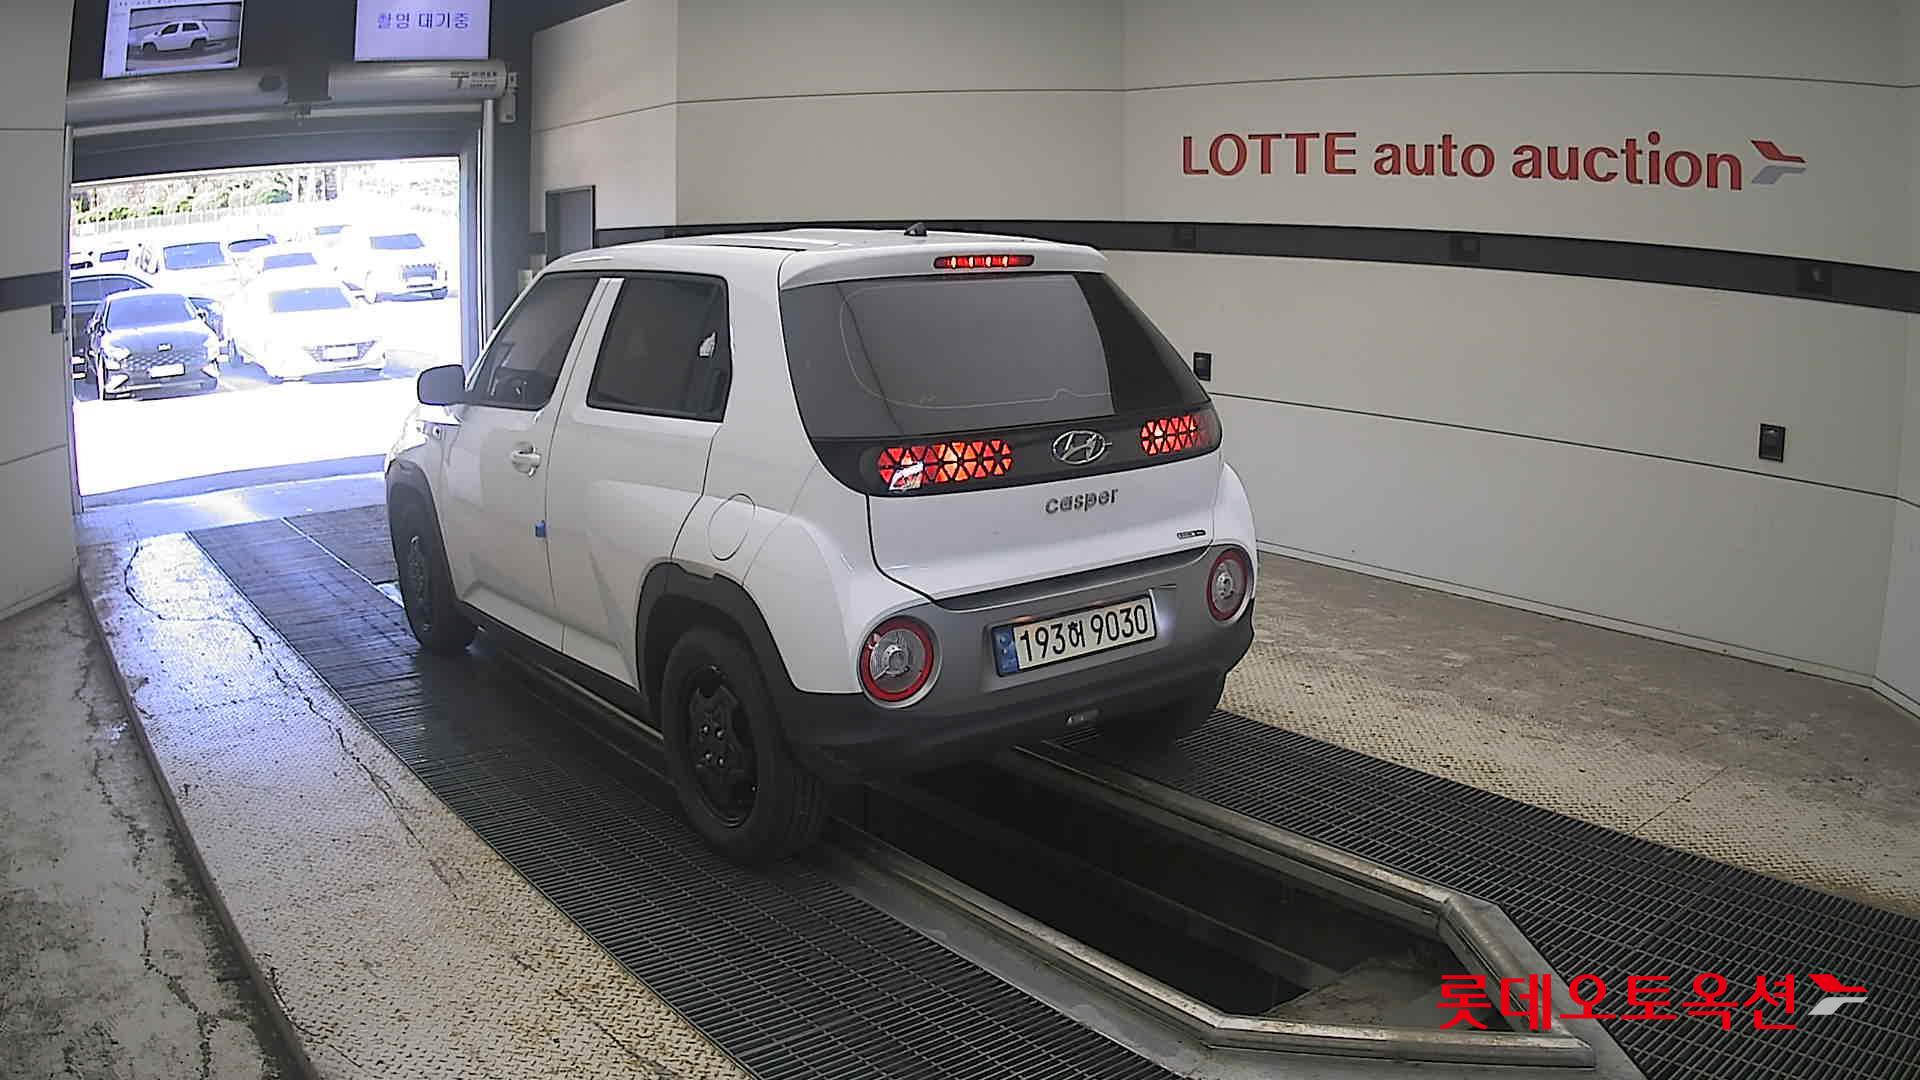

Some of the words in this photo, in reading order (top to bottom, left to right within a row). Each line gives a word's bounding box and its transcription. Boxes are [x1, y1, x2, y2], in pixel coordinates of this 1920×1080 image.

[418, 12, 468, 29] 대기중
[1182, 131, 1358, 176] LOTTE
[1374, 133, 1496, 177] auto
[1511, 131, 1743, 191] auction
[1045, 489, 1119, 514] casper
[1020, 620, 1086, 662] 193허
[1090, 604, 1148, 645] 9030
